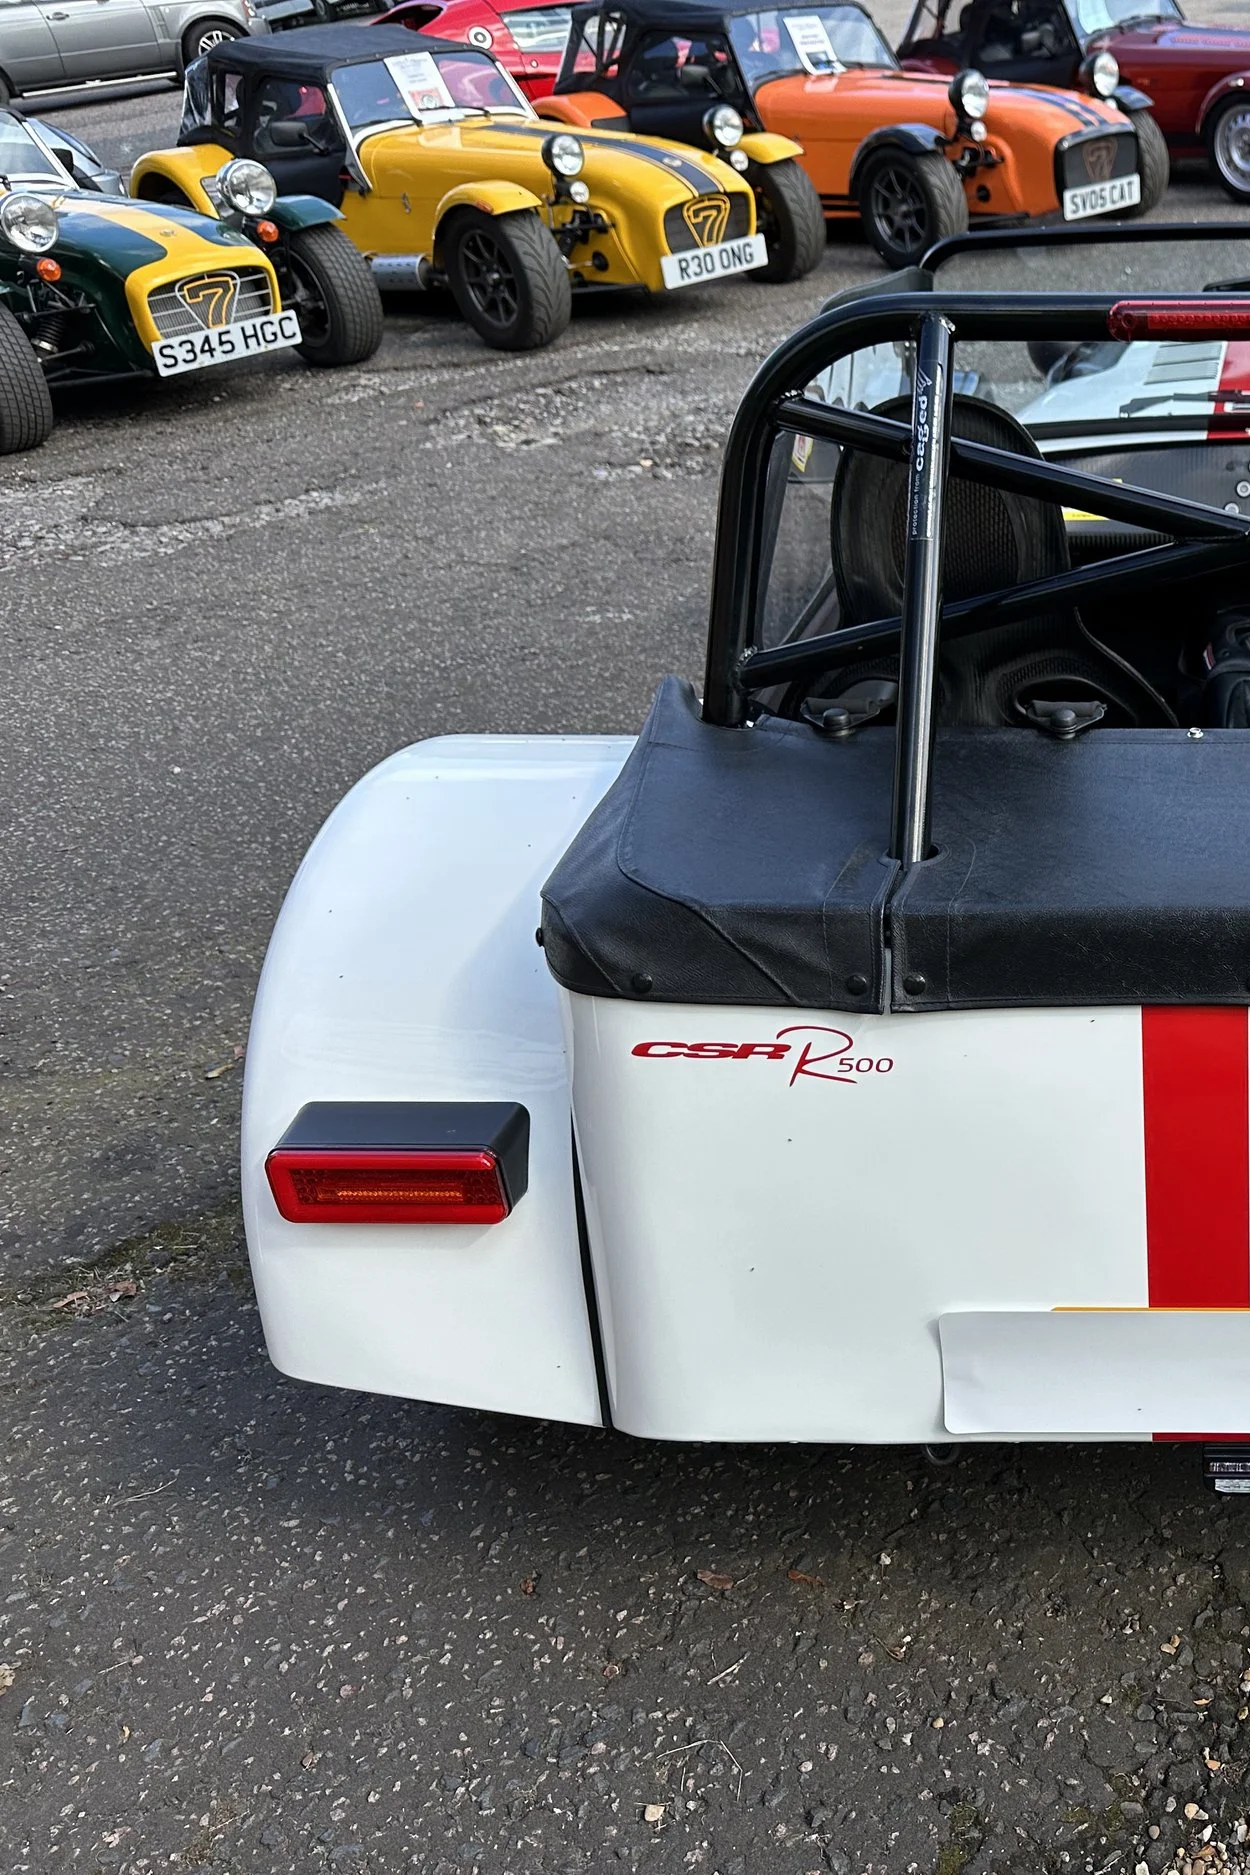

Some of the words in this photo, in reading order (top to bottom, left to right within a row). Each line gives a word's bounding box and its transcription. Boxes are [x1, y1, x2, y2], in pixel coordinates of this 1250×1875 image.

[1070, 187, 1107, 214] SV05
[1109, 180, 1134, 204] CAT
[687, 200, 726, 248] 7
[678, 252, 716, 281] R30
[719, 242, 754, 270] ONG
[183, 276, 234, 329] 7
[159, 331, 236, 369] S345
[241, 316, 297, 349] HGC
[916, 395, 929, 472] caged
[631, 1042, 792, 1060] CSR
